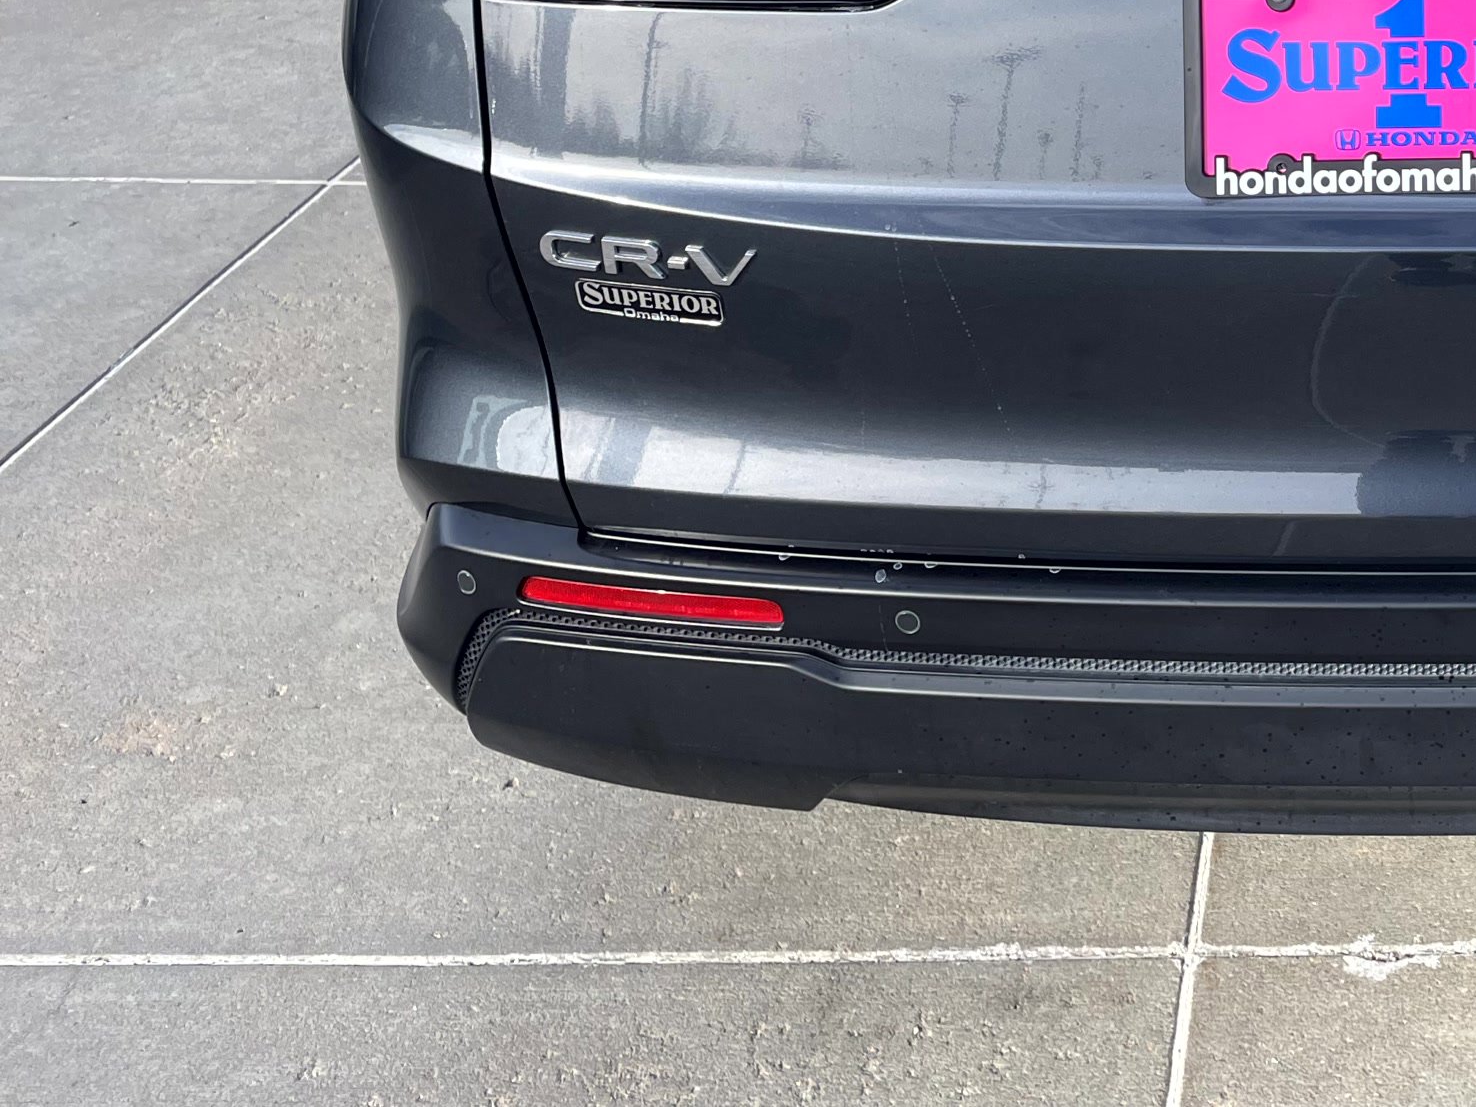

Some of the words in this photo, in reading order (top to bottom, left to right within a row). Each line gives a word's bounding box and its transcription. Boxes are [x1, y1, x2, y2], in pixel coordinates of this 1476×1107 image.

[539, 229, 758, 287] CR-V
[581, 280, 719, 316] SUPERIOR
[623, 307, 680, 323] Omaha
